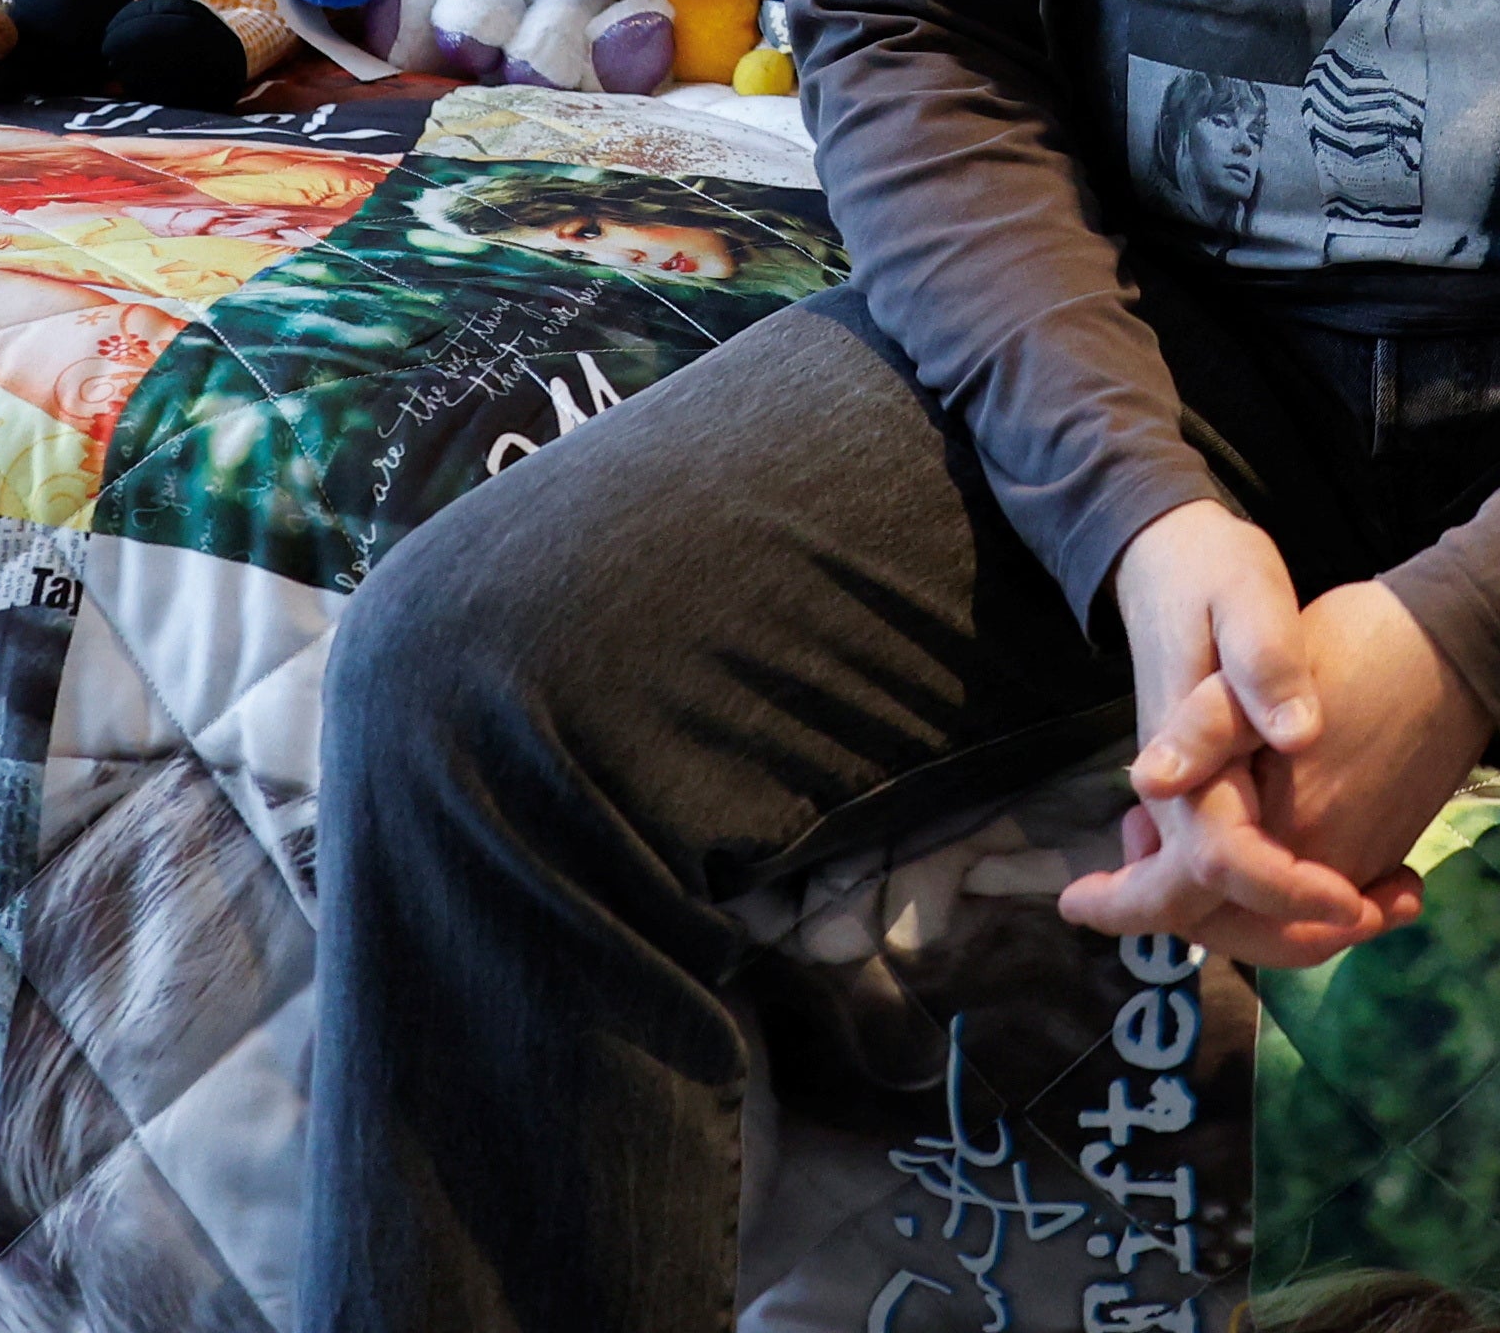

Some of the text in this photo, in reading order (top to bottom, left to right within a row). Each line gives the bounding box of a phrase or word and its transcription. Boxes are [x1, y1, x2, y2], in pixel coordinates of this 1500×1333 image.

[443, 344, 478, 381] best
[378, 384, 447, 439] the
[373, 444, 405, 506] are
[1078, 934, 1201, 1333] Fiftee
